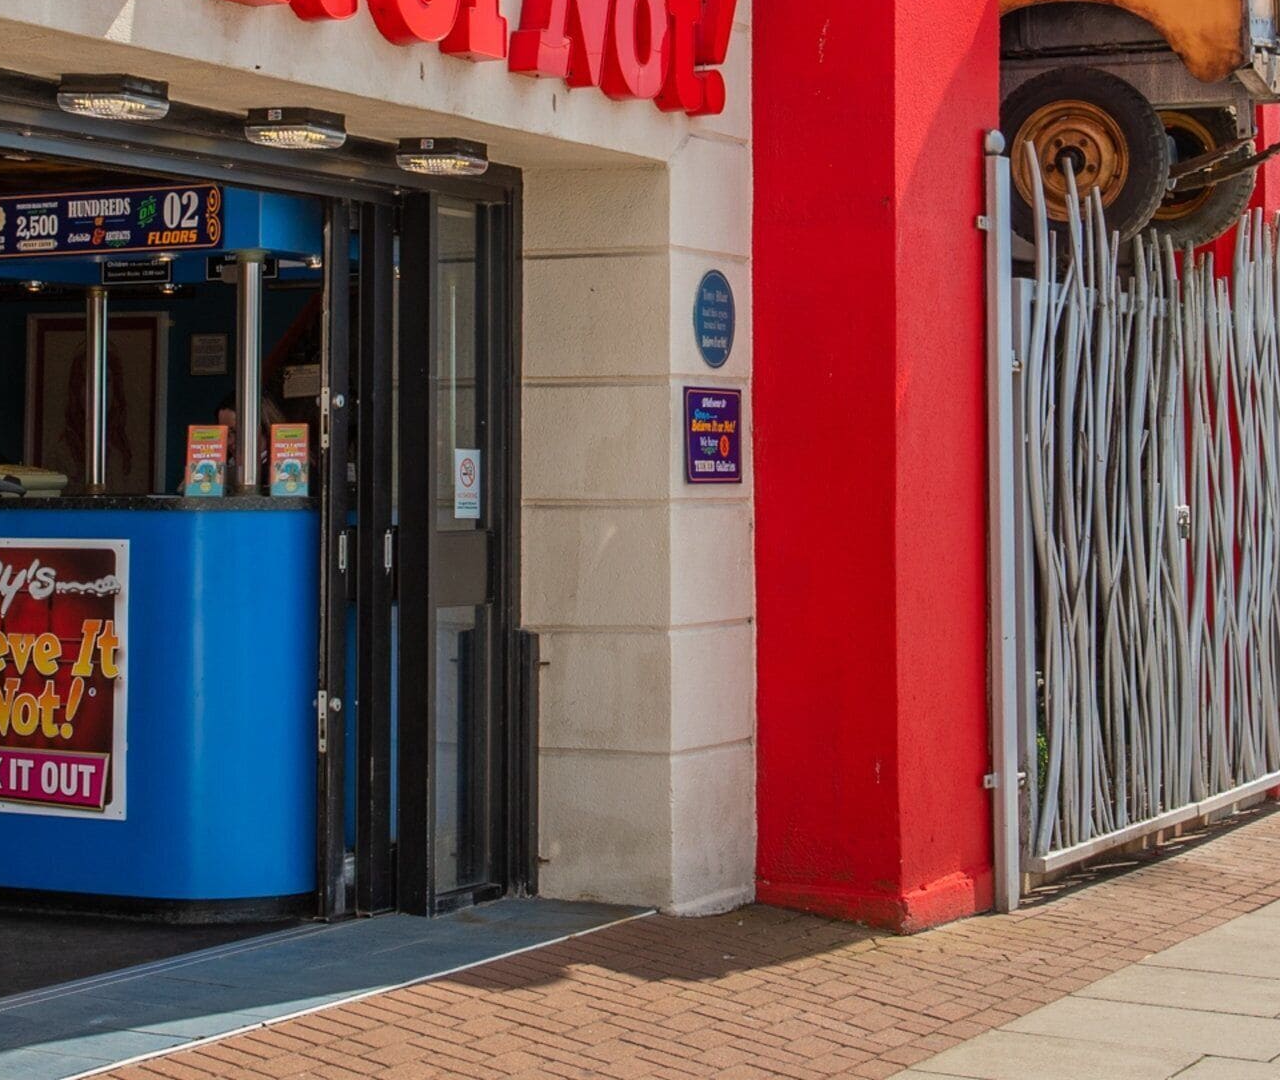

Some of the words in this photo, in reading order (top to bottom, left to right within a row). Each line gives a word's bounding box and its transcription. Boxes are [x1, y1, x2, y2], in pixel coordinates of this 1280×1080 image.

[68, 197, 131, 218] HUNDREDS
[163, 191, 199, 228] 02
[16, 215, 58, 239] 2,500
[147, 230, 198, 245] FLOORS
[71, 619, 120, 678] It
[9, 758, 34, 791] IT
[41, 761, 95, 797] OUT
